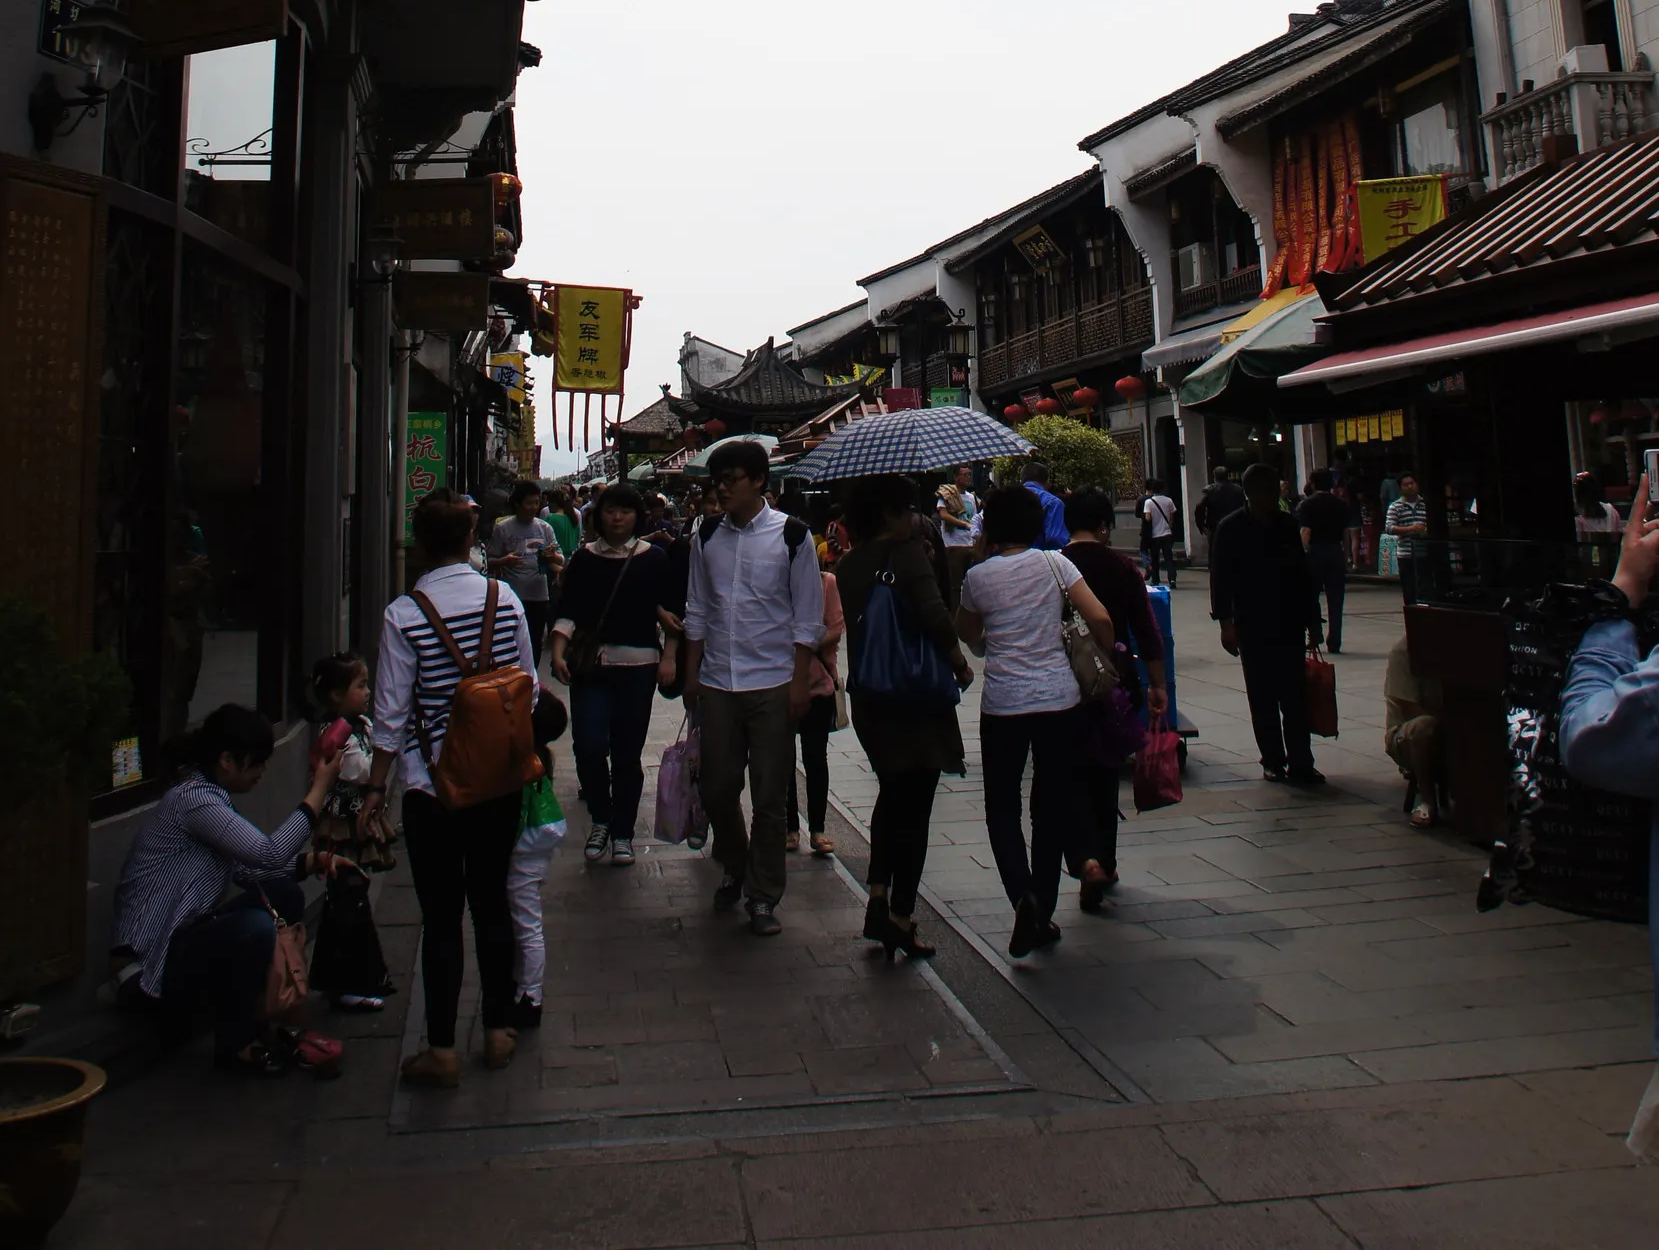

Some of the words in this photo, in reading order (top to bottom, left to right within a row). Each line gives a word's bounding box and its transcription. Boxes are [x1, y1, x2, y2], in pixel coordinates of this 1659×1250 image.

[1383, 197, 1422, 251] 手工
[577, 301, 600, 366] 友军牌
